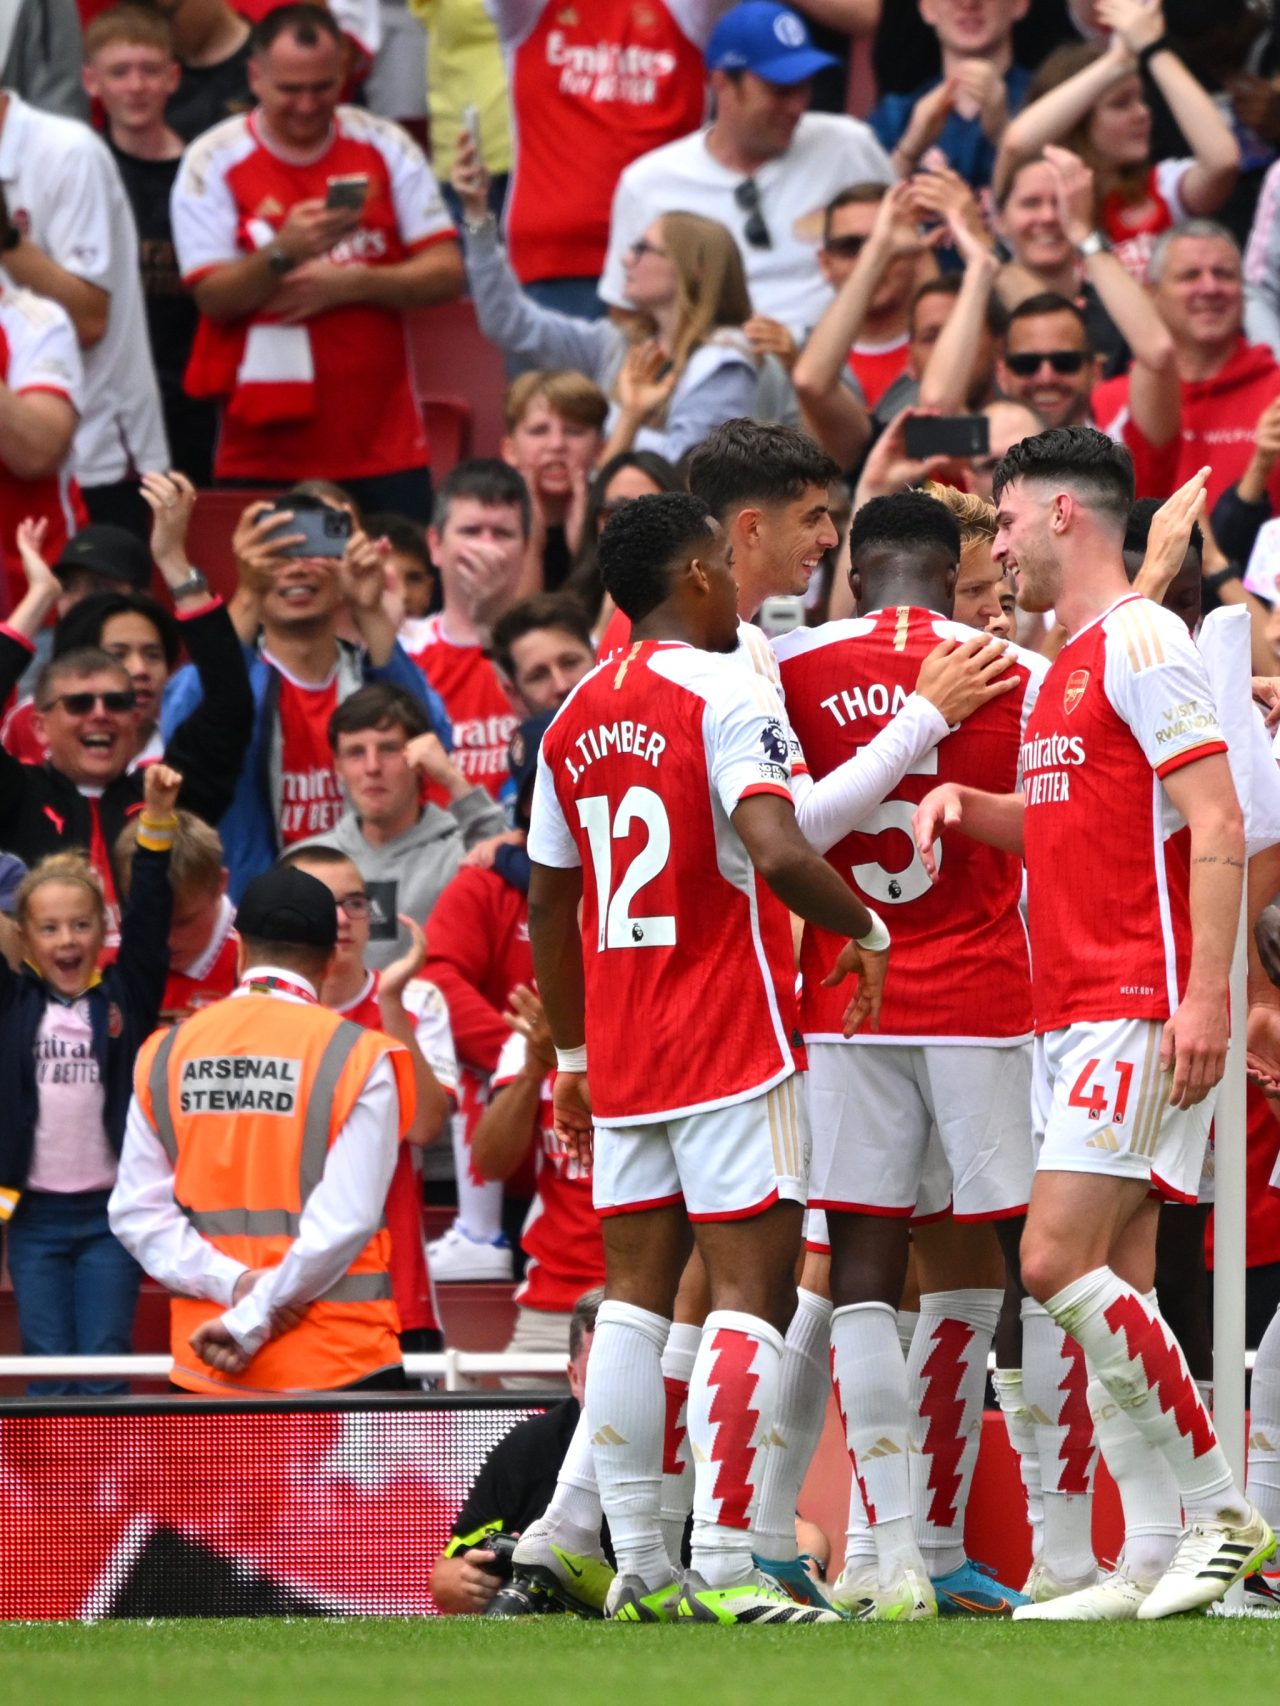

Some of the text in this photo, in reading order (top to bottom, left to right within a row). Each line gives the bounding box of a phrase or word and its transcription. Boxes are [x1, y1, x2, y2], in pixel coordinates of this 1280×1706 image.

[820, 684, 908, 727] THO
[565, 720, 666, 784] J.TIMBER
[1021, 731, 1086, 773] mirates
[576, 785, 676, 953] 12
[53, 1062, 99, 1084] BETTE
[183, 1059, 295, 1081] ARSENAL
[180, 1089, 295, 1113] STEWARD
[1068, 1058, 1135, 1125] 41
